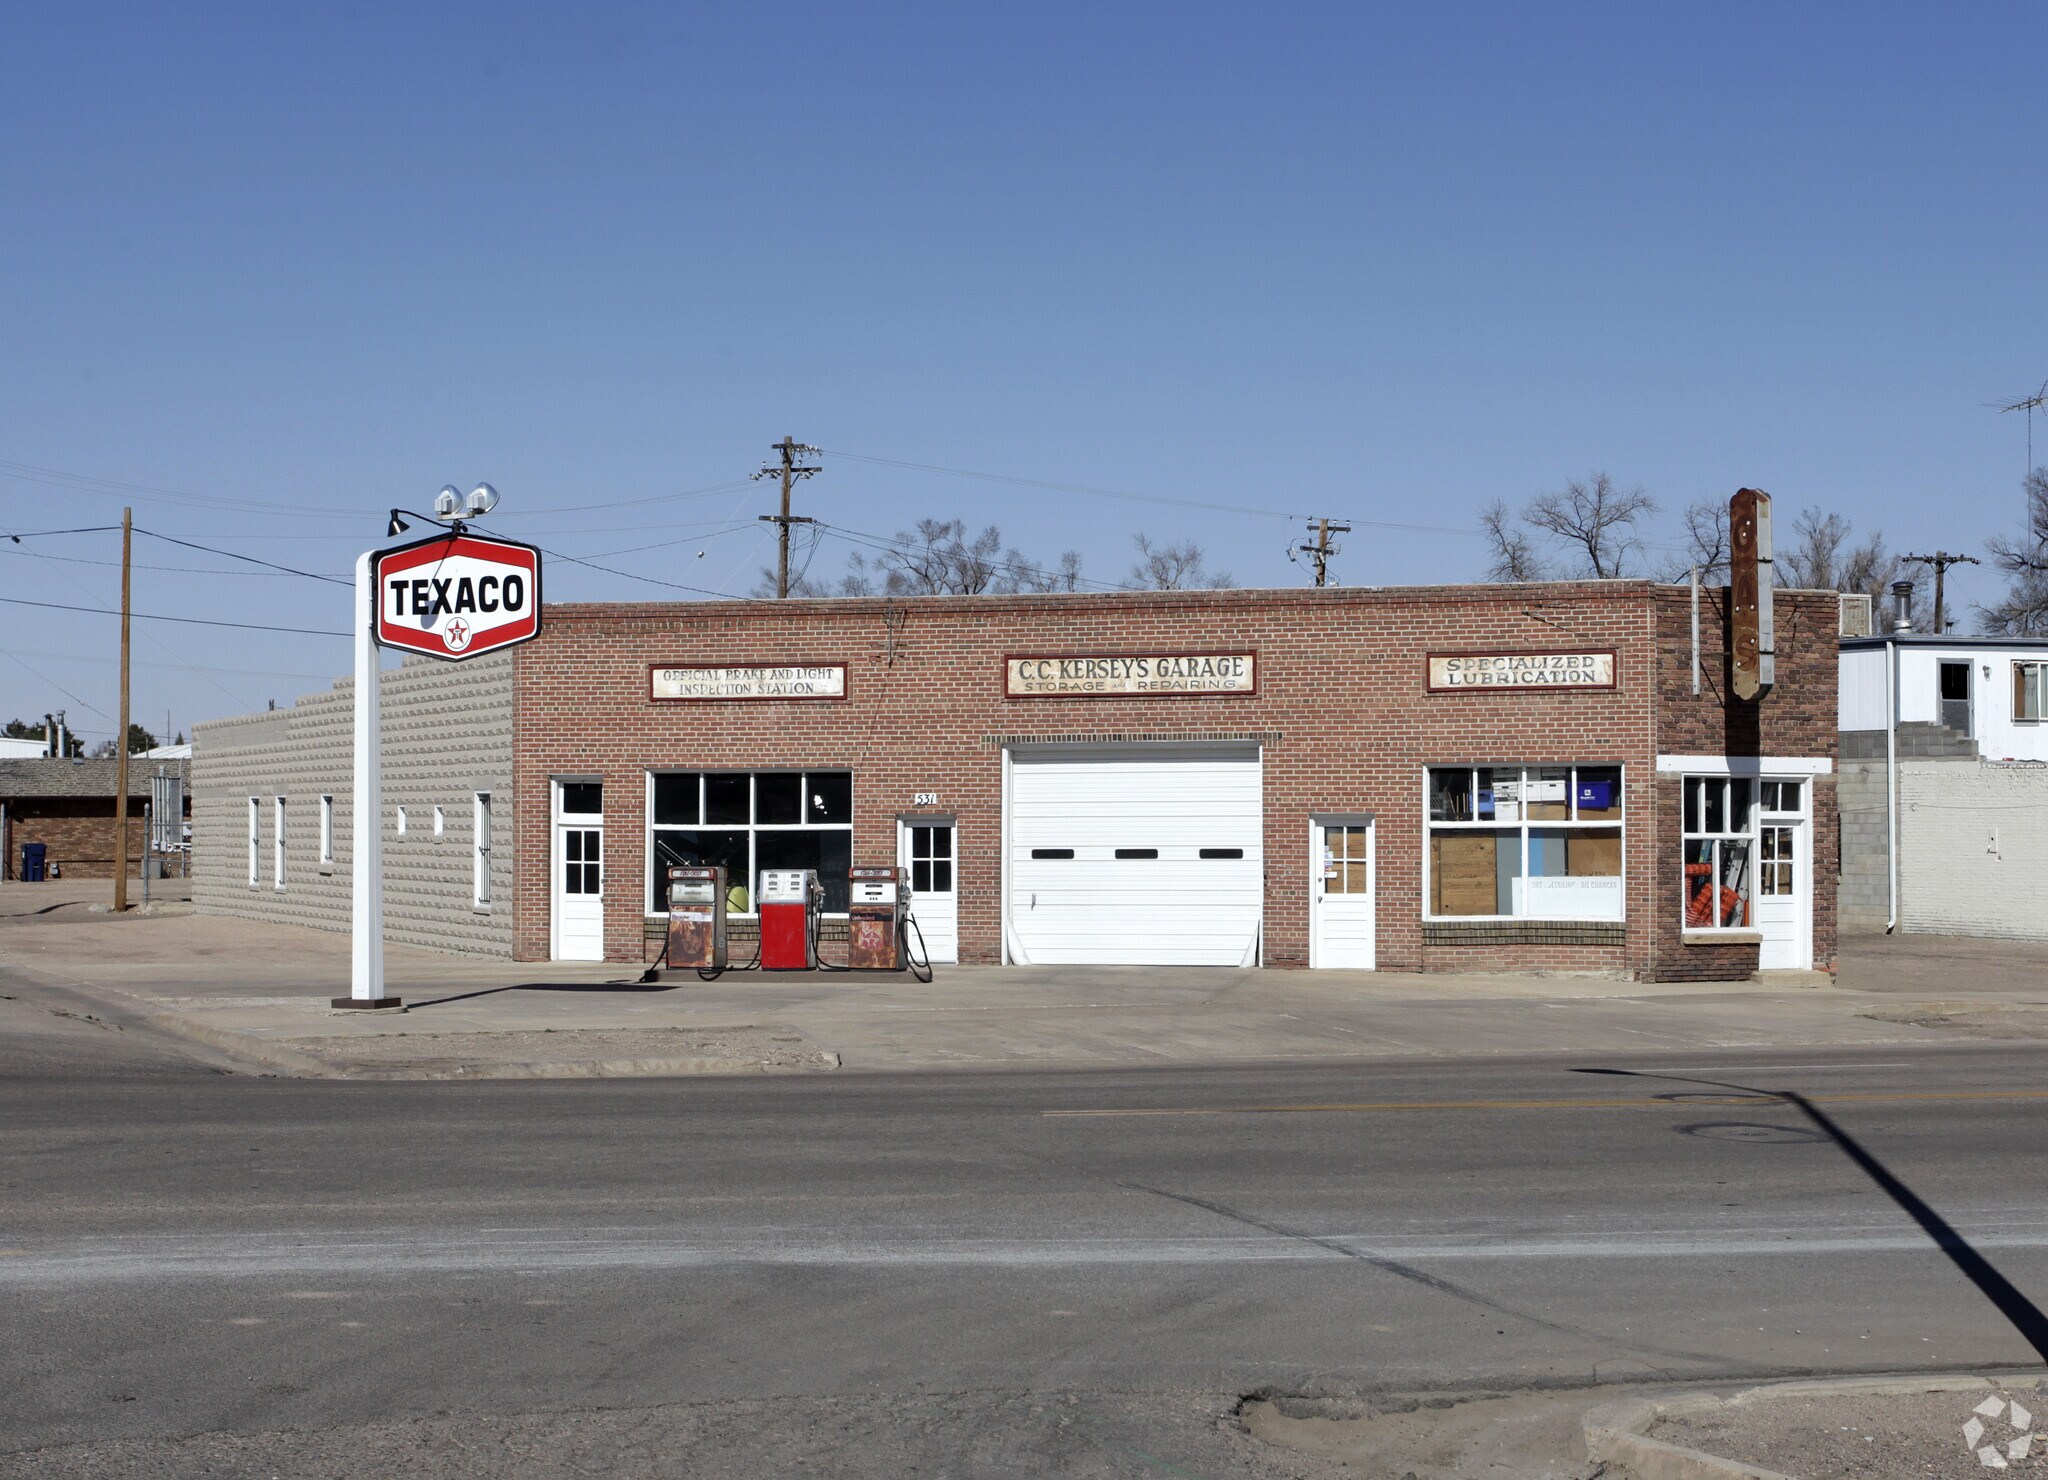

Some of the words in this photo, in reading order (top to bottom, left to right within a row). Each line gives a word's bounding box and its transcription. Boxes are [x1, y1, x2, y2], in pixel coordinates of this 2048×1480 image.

[390, 574, 524, 616] TEXACO
[1059, 657, 1149, 680] KERSEY'S
[1156, 656, 1244, 678] GARAGE
[1446, 656, 1595, 672] SPECIALIZED
[663, 670, 721, 682] OFFICIAL
[725, 669, 767, 681] BRAKE
[769, 668, 794, 680] AND
[796, 668, 834, 680] LIGHT
[1448, 670, 1596, 685] LUBRICATION
[679, 683, 751, 696] INSPECTION
[757, 682, 815, 694] STATION
[1024, 681, 1105, 692] STORAGE
[1137, 679, 1236, 690] REPAIRING
[917, 794, 934, 805] 531
[1580, 881, 1590, 889] OIL
